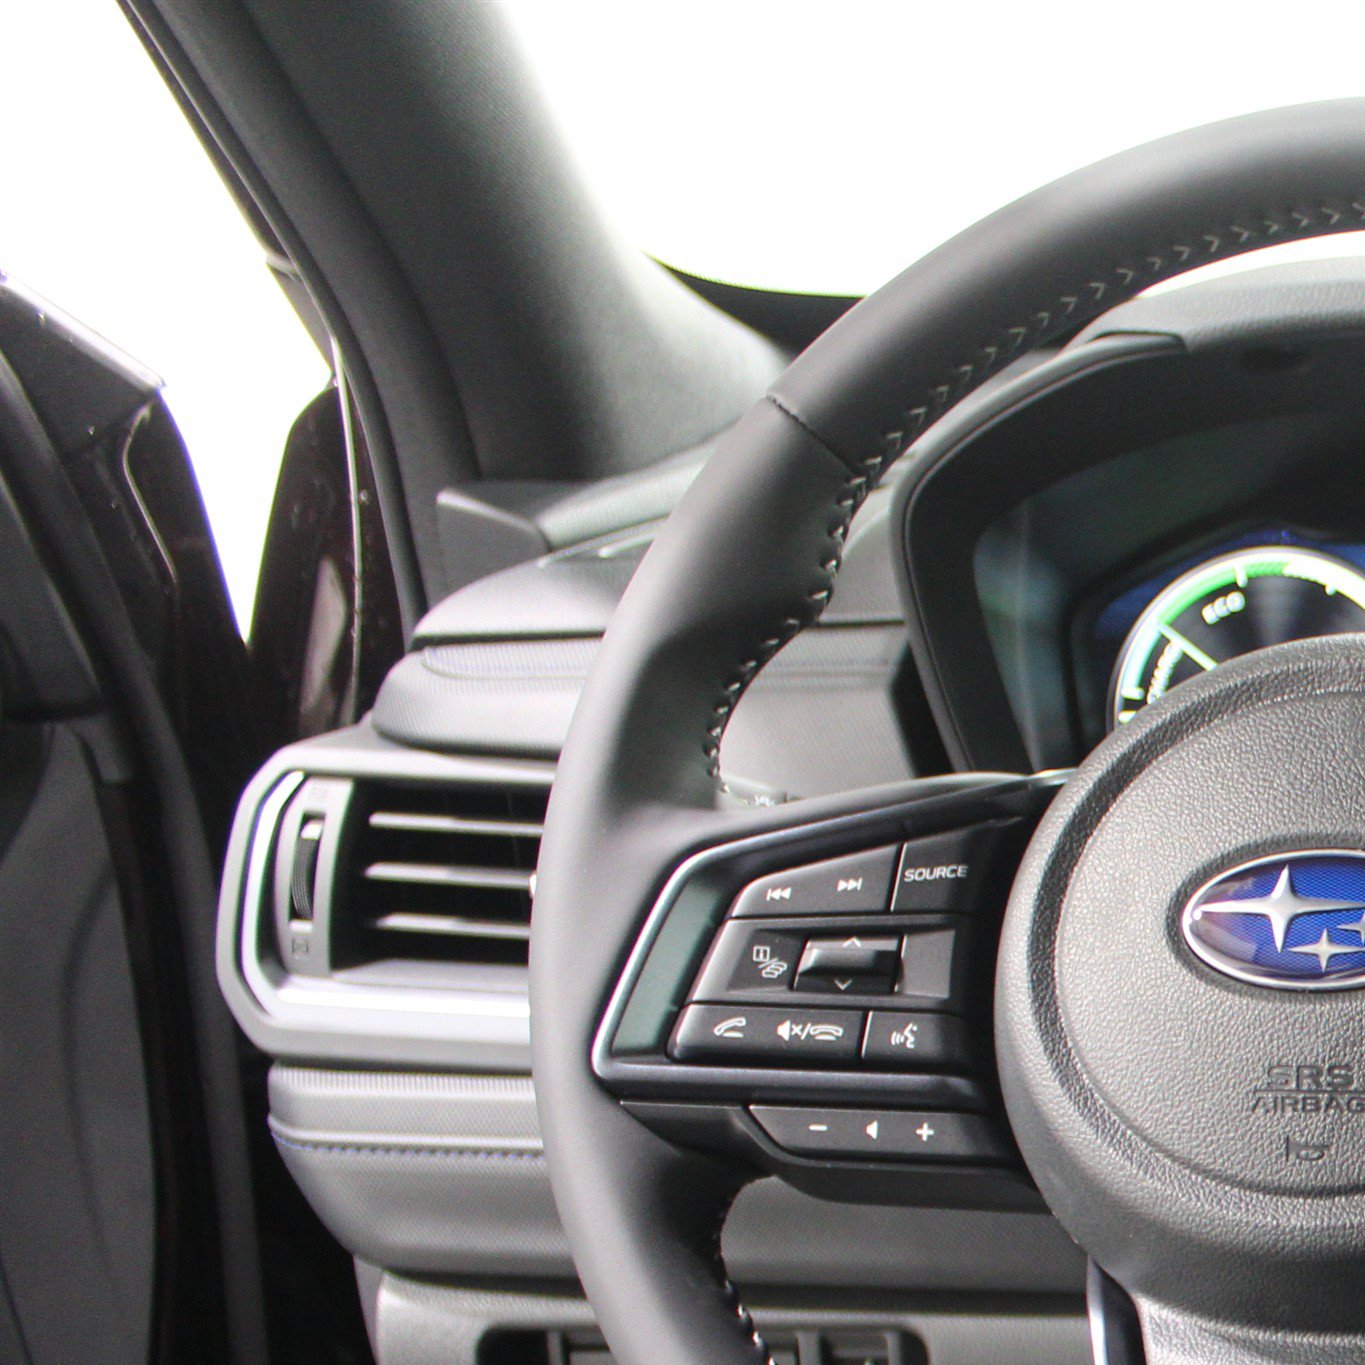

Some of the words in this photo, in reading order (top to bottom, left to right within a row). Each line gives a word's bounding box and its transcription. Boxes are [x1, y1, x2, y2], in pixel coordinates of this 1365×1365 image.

[1201, 591, 1246, 625] ECO
[904, 864, 968, 883] SOURCE
[1267, 1065, 1355, 1090] SRS
